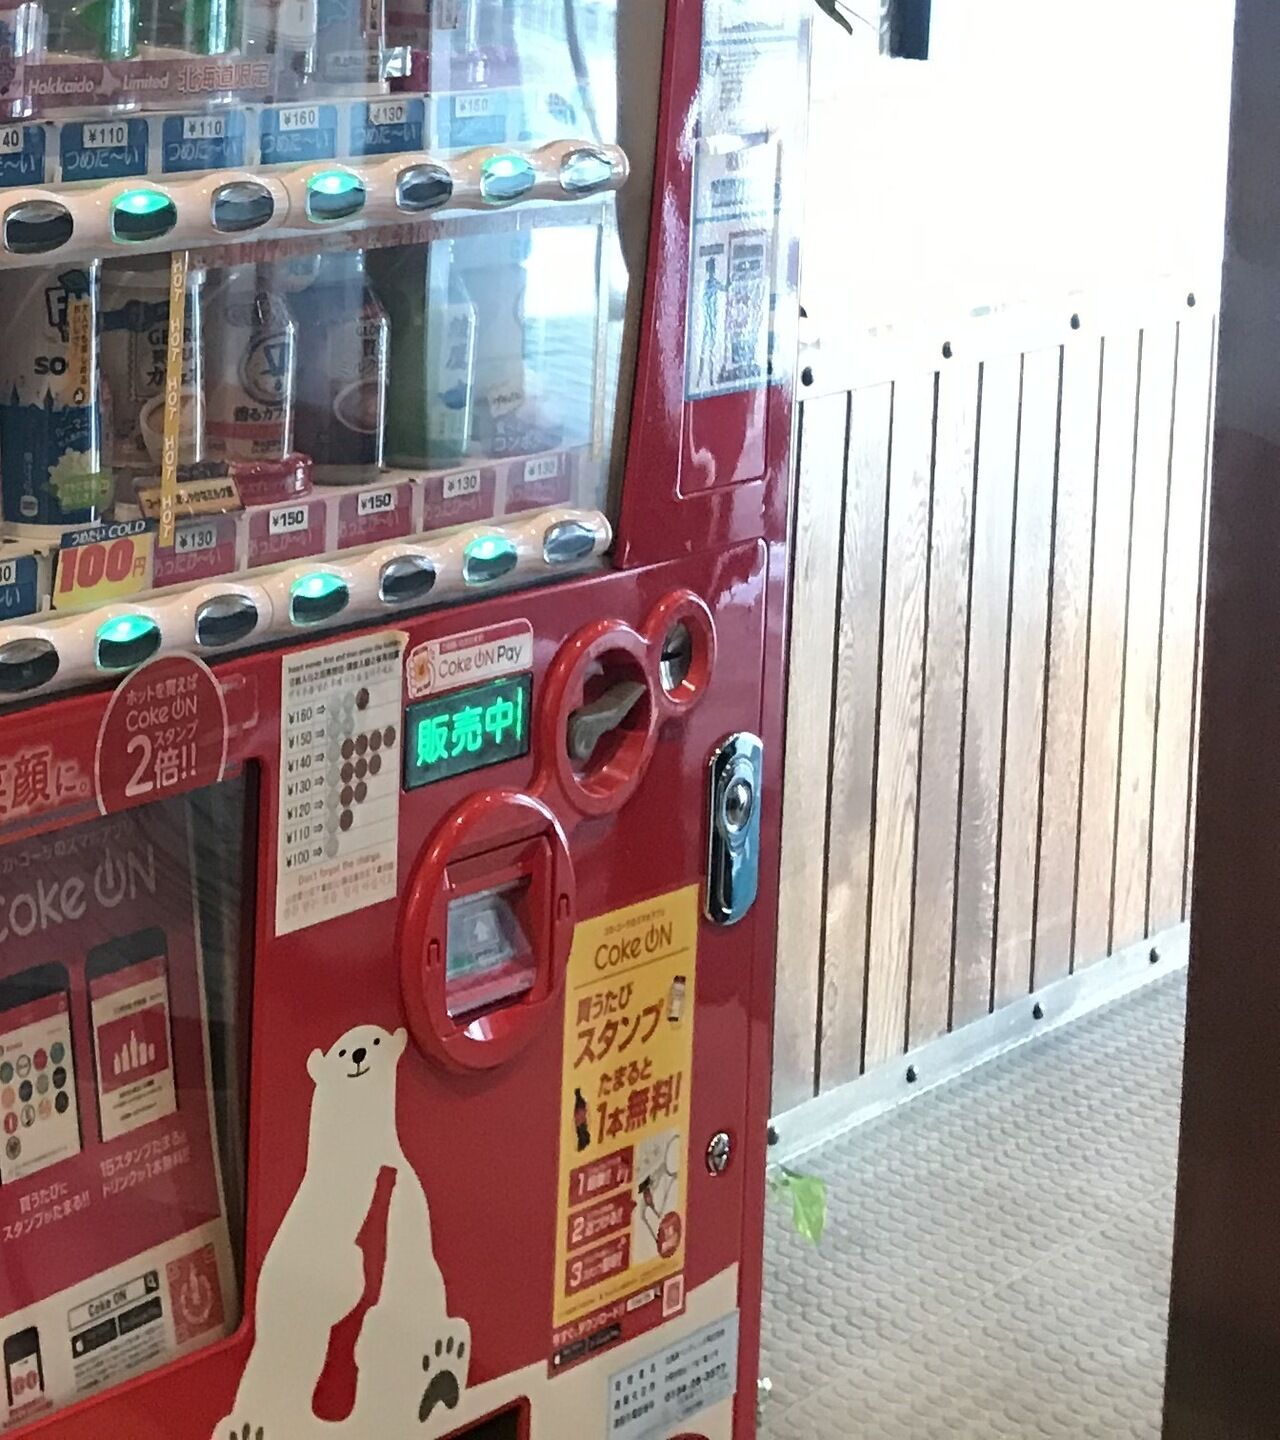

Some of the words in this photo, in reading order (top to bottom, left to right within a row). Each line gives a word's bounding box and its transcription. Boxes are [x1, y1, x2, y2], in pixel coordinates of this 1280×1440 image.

[28, 77, 95, 95] Hokkaido
[123, 73, 169, 90] Limited
[177, 64, 270, 93] 北海道限定
[188, 119, 222, 136] ¥110
[283, 110, 315, 126] ¥160
[87, 127, 124, 143] ¥110
[172, 259, 183, 301] HOT
[171, 320, 180, 360] HOT
[168, 377, 178, 419] HOT
[165, 436, 175, 480] HOT
[447, 476, 478, 493] ¥130
[361, 493, 391, 509] ¥150
[162, 495, 172, 538] HOT
[272, 510, 305, 527] ¥150
[70, 527, 104, 544] つめたい
[108, 520, 146, 539] COLD
[179, 529, 214, 549] ¥130
[439, 655, 471, 678] Coke
[497, 645, 522, 663] Pay
[127, 673, 198, 706] ホットを買えば
[127, 706, 168, 731] Coke
[172, 696, 197, 719] ON
[288, 708, 312, 724] ¥160
[155, 719, 198, 748] スタンプ
[288, 731, 312, 748] ¥150
[417, 699, 516, 767] 販売中
[125, 735, 196, 797] 2倍!!
[287, 755, 312, 772] ¥140
[287, 778, 311, 796] ¥130
[287, 803, 311, 820] ¥120
[286, 826, 310, 844] ¥110
[286, 850, 310, 868] ¥100
[94, 844, 155, 907] ON
[594, 936, 641, 970] Coke
[645, 922, 672, 952] ON
[577, 981, 634, 1025] 買うたび
[574, 998, 664, 1069] スタンプ
[598, 1057, 652, 1097] たまると
[597, 1071, 682, 1144] 1本無料!
[571, 1216, 584, 1242] 2
[570, 1262, 582, 1287] 3
